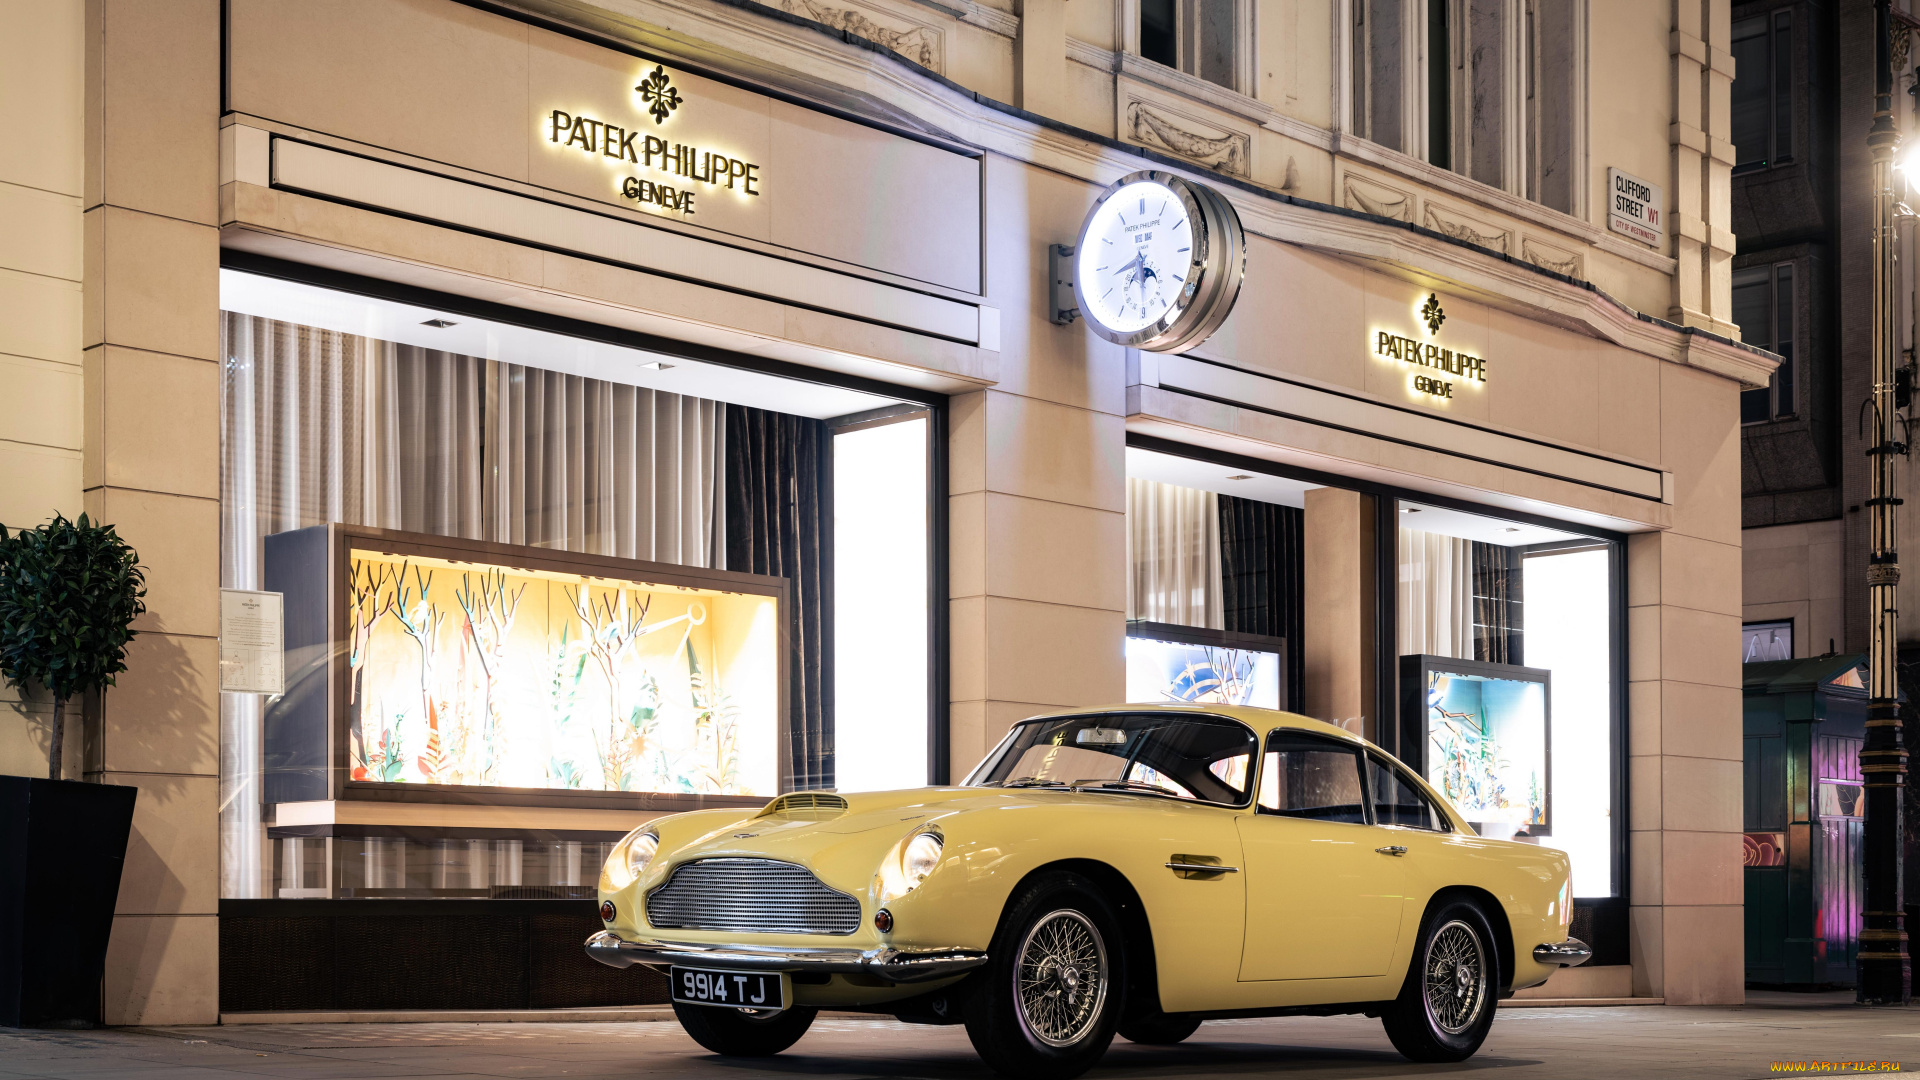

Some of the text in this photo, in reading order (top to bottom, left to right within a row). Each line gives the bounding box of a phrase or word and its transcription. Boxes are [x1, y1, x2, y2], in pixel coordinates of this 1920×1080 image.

[552, 110, 760, 196] PATEK PHILIPPE
[622, 176, 696, 214] GENEVE
[1616, 175, 1651, 203] CLIFFORD
[1616, 194, 1659, 226] STREET W1
[1125, 219, 1161, 233] PATEK PHILIPPE
[1616, 219, 1656, 241] CITY OF WESTMINSTER
[1141, 306, 1146, 319] 9
[1379, 331, 1486, 382] PATEK PHILIPPE
[1414, 375, 1453, 399] GENEVE
[683, 972, 766, 1003] 9914 TJ
